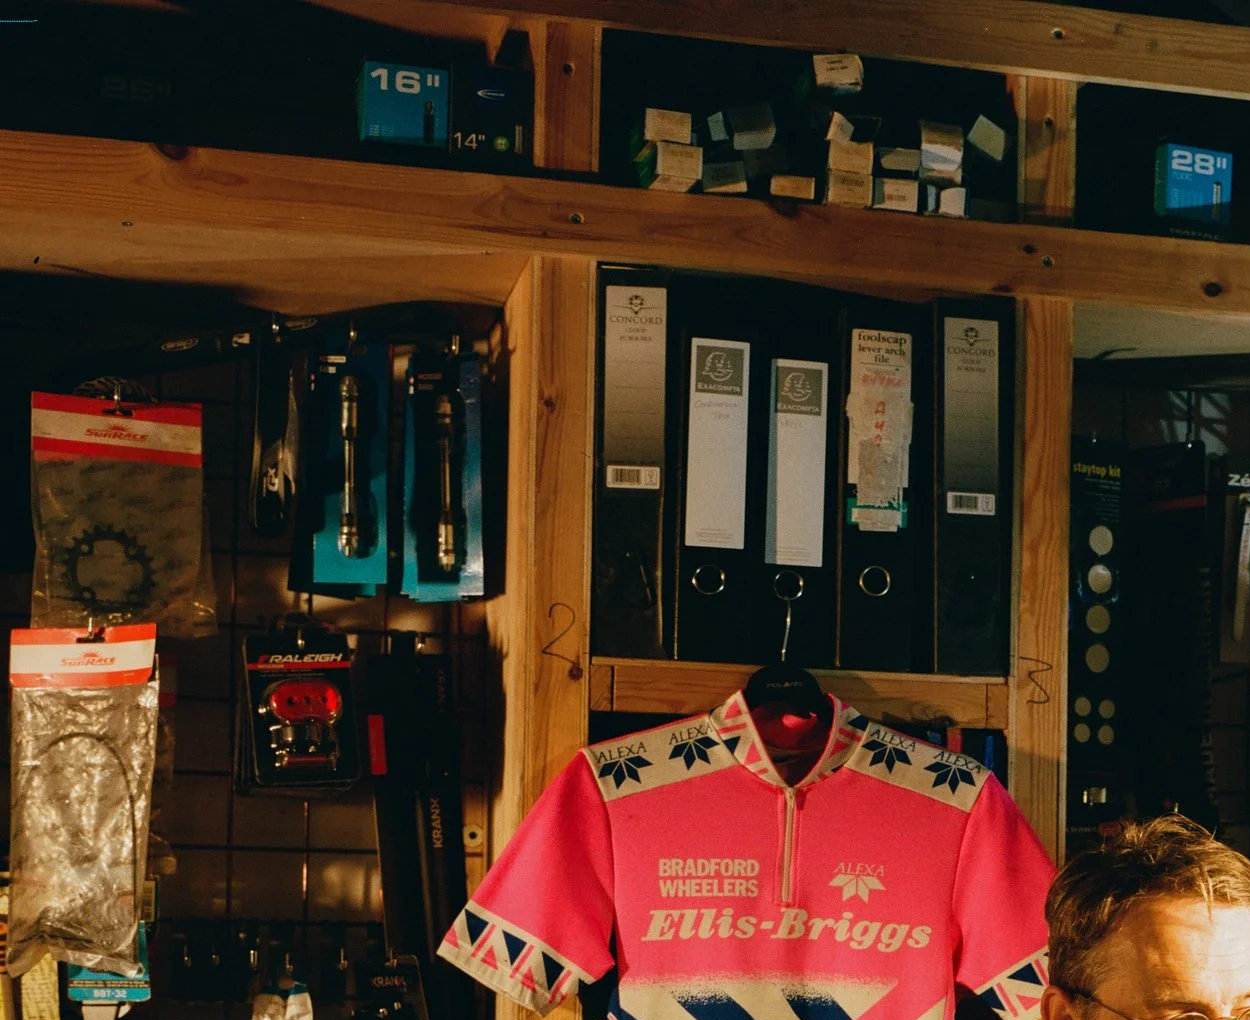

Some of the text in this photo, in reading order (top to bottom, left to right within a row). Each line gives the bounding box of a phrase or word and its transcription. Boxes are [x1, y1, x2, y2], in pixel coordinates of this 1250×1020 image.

[370, 67, 440, 95] 16"
[453, 131, 486, 150] 14"
[1171, 149, 1227, 176] 28"
[608, 314, 664, 326] CONCORD
[857, 331, 908, 348] foolscap
[858, 344, 907, 357] lever arch
[874, 354, 890, 364] file
[1072, 462, 1121, 478] staytop kit
[269, 652, 344, 664] RALEIGH
[668, 720, 714, 746] ALEXA
[869, 728, 917, 753] ALEXA
[597, 741, 648, 764] ALEXA
[932, 750, 983, 775] ALEXA
[658, 858, 760, 878] BRADFORD
[832, 861, 886, 877] ALEXA
[658, 879, 760, 898] WHEELERS
[640, 907, 933, 953] Ellis-Briggs
